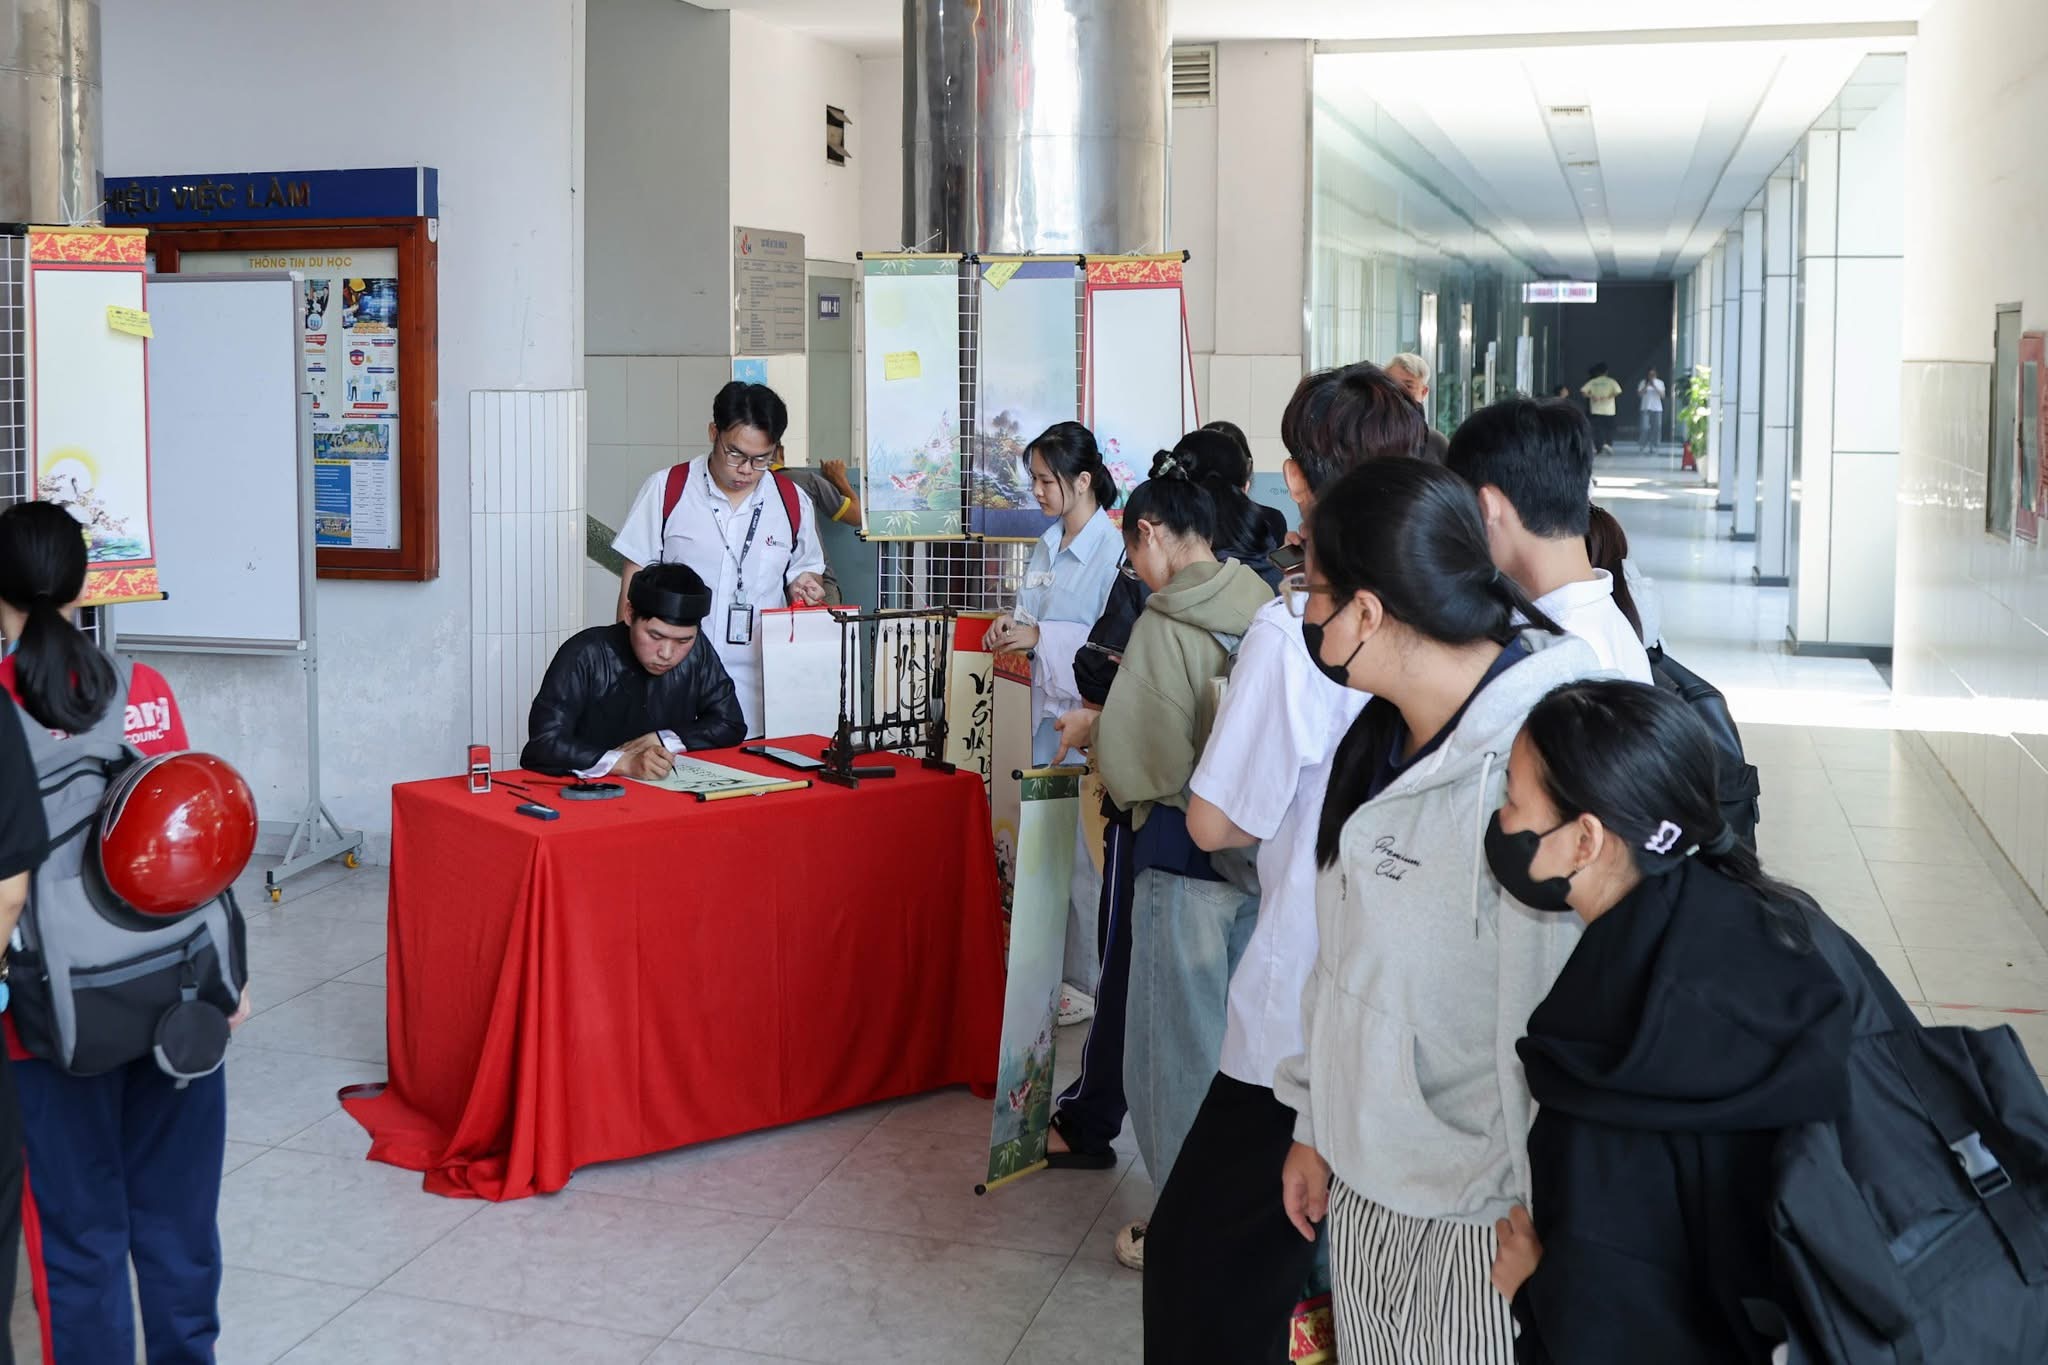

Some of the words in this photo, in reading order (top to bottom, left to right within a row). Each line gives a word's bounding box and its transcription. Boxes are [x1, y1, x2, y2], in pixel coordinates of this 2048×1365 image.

[171, 178, 235, 217] VIỆC
[248, 255, 287, 269] THÔNG
[290, 257, 305, 268] TIN
[309, 256, 323, 267] DU
[327, 256, 352, 270] HỌC
[1371, 835, 1422, 867] Premium
[1375, 858, 1408, 881] Club
